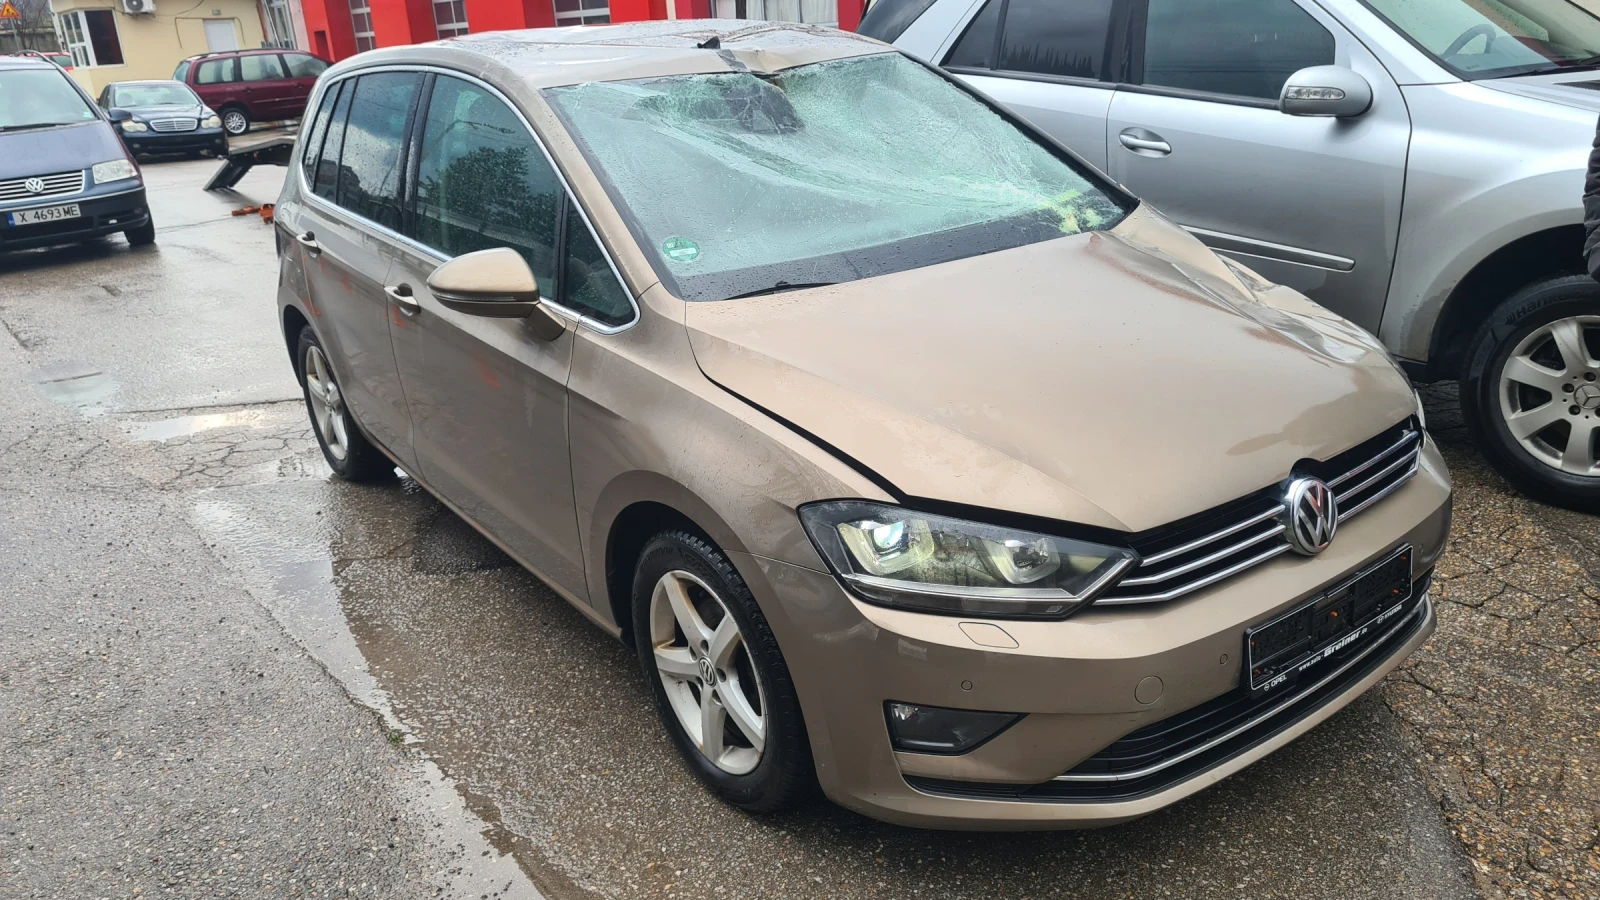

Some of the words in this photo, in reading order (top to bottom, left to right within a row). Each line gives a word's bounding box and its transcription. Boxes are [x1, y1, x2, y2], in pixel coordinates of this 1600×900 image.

[25, 178, 44, 193] VW
[19, 212, 28, 223] X
[1293, 479, 1336, 551] VW
[700, 658, 715, 685] VW
[1271, 674, 1287, 687] OPEL
